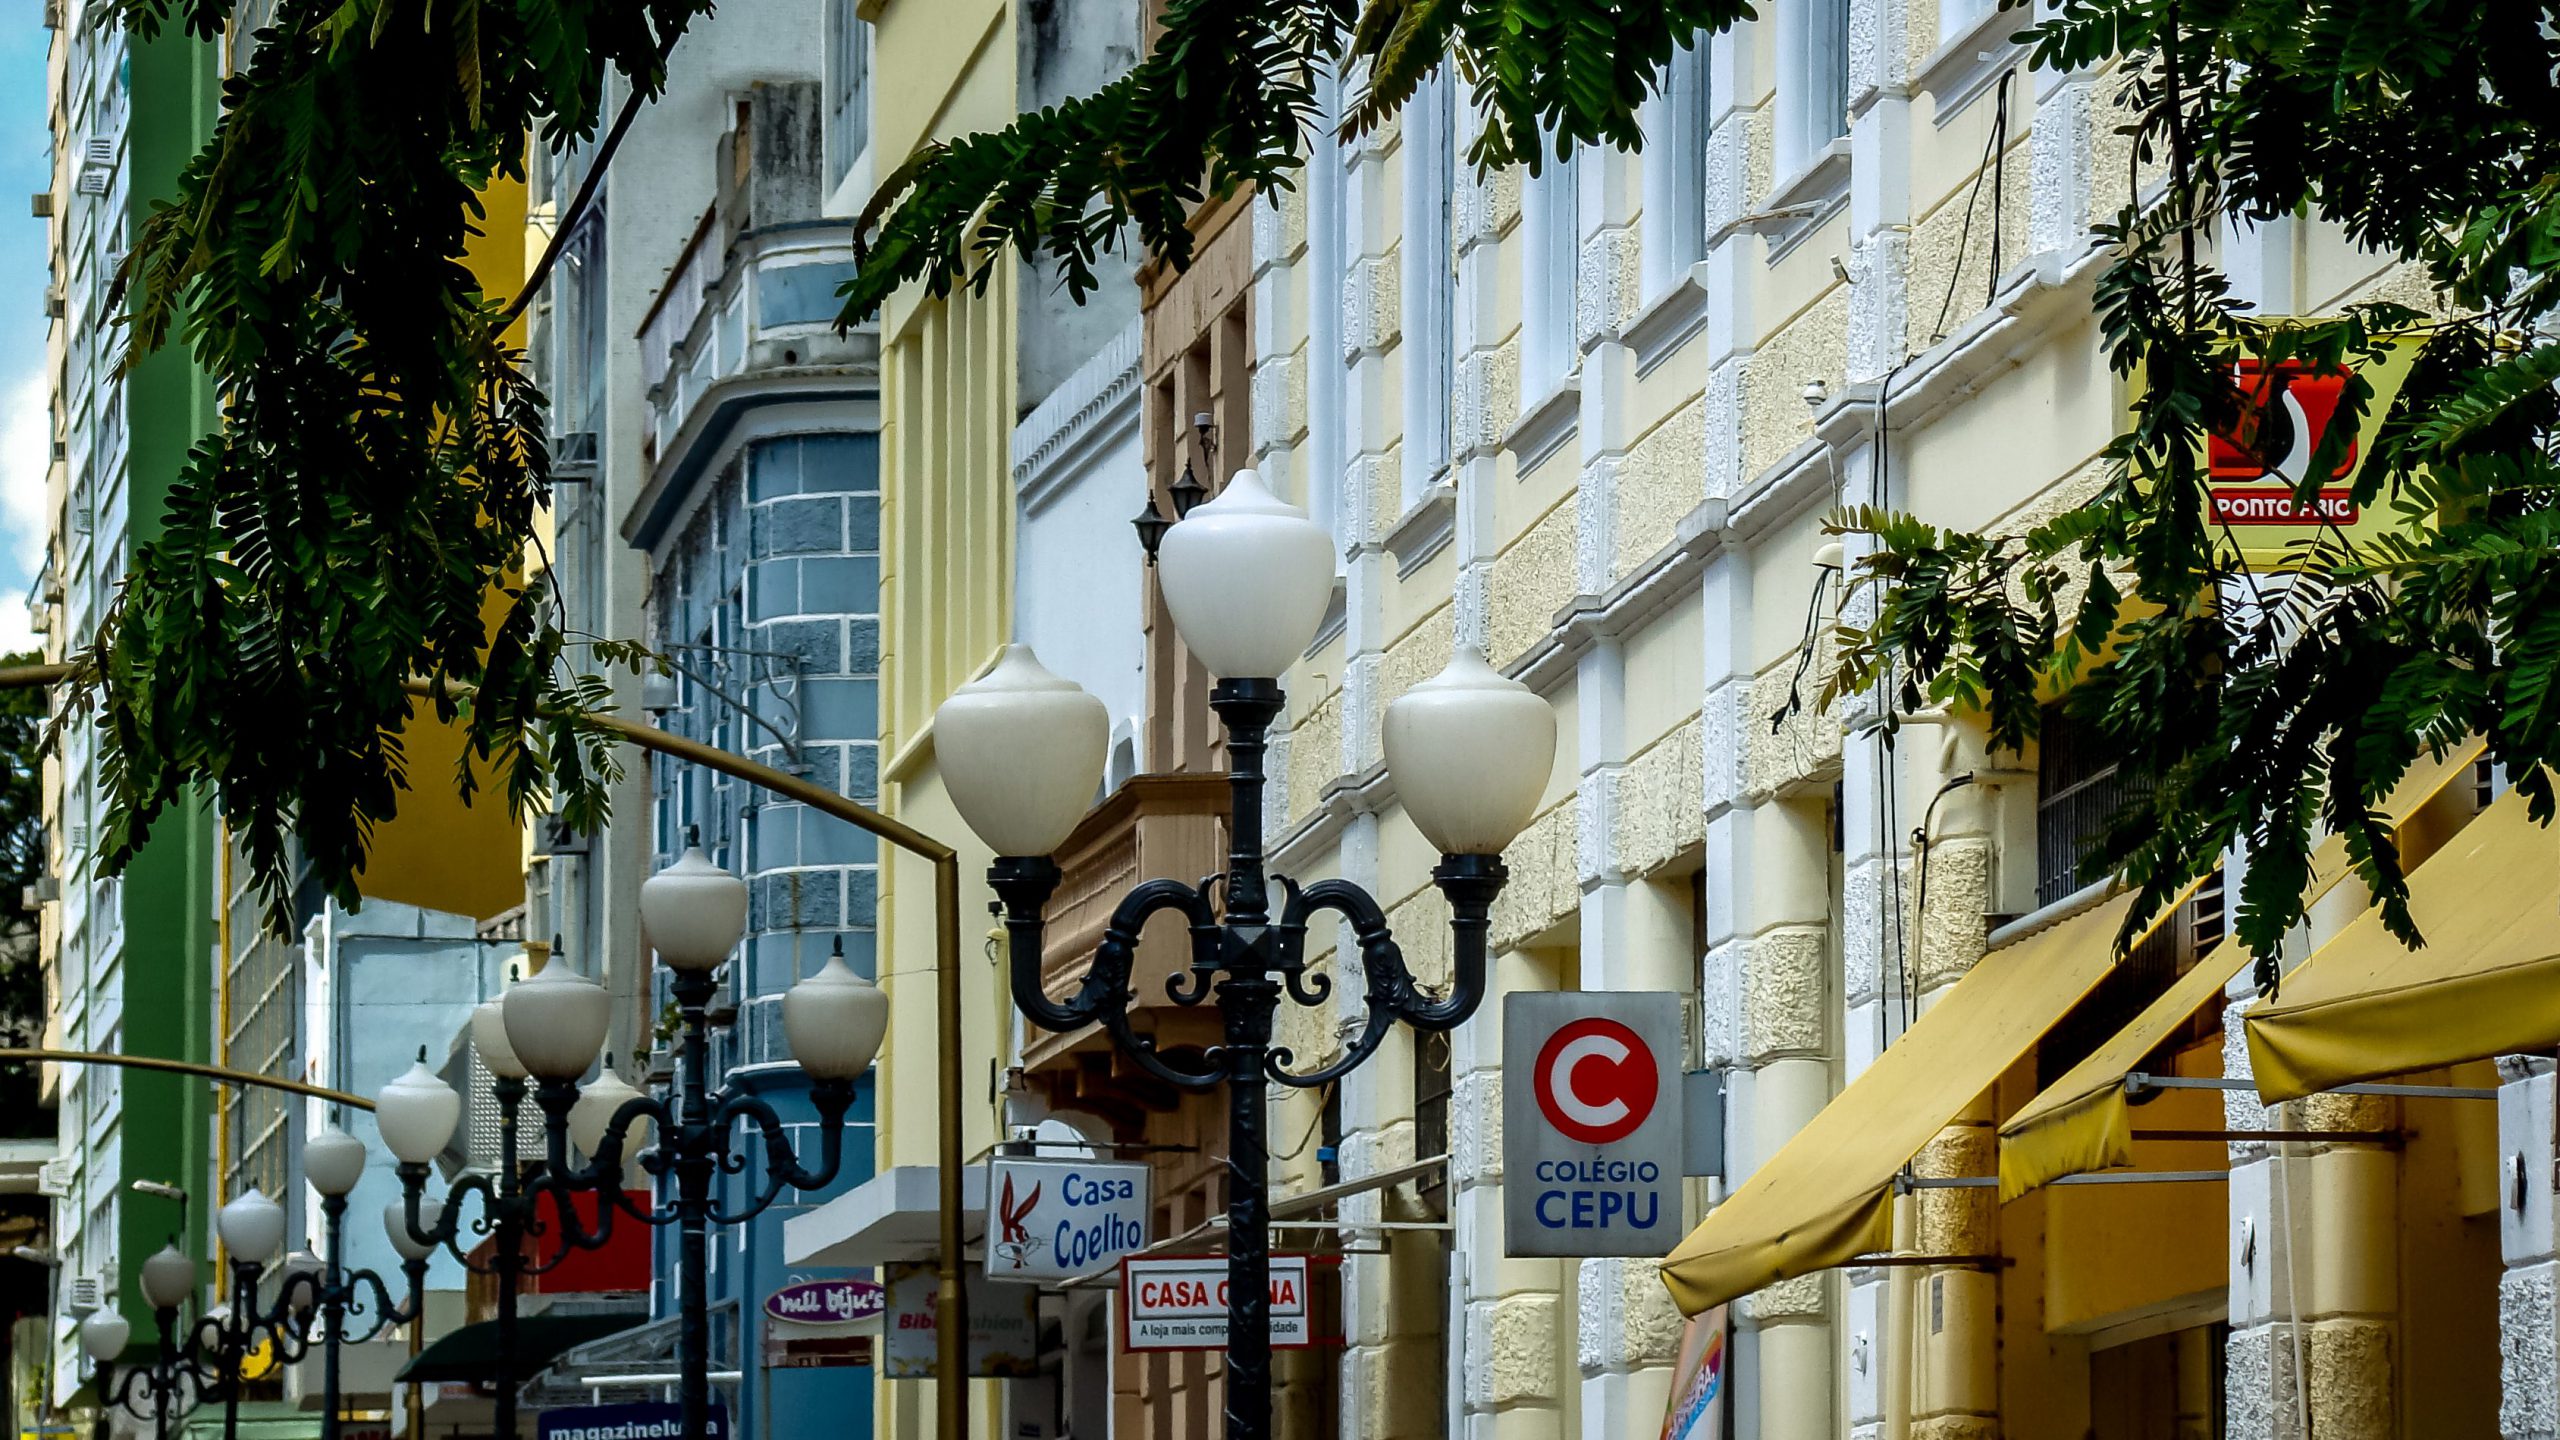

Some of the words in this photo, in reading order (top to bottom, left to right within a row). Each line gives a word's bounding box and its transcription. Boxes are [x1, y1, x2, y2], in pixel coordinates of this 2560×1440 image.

[1535, 1154, 1660, 1183] COLÉGIO
[1062, 1173, 1134, 1207] Casa
[1535, 1189, 1659, 1230] CEPU
[1054, 1212, 1142, 1269] Coelho
[1141, 1281, 1209, 1308] CASA
[1140, 1324, 1149, 1336] A
[1150, 1323, 1169, 1339] loja
[1172, 1322, 1196, 1336] mais
